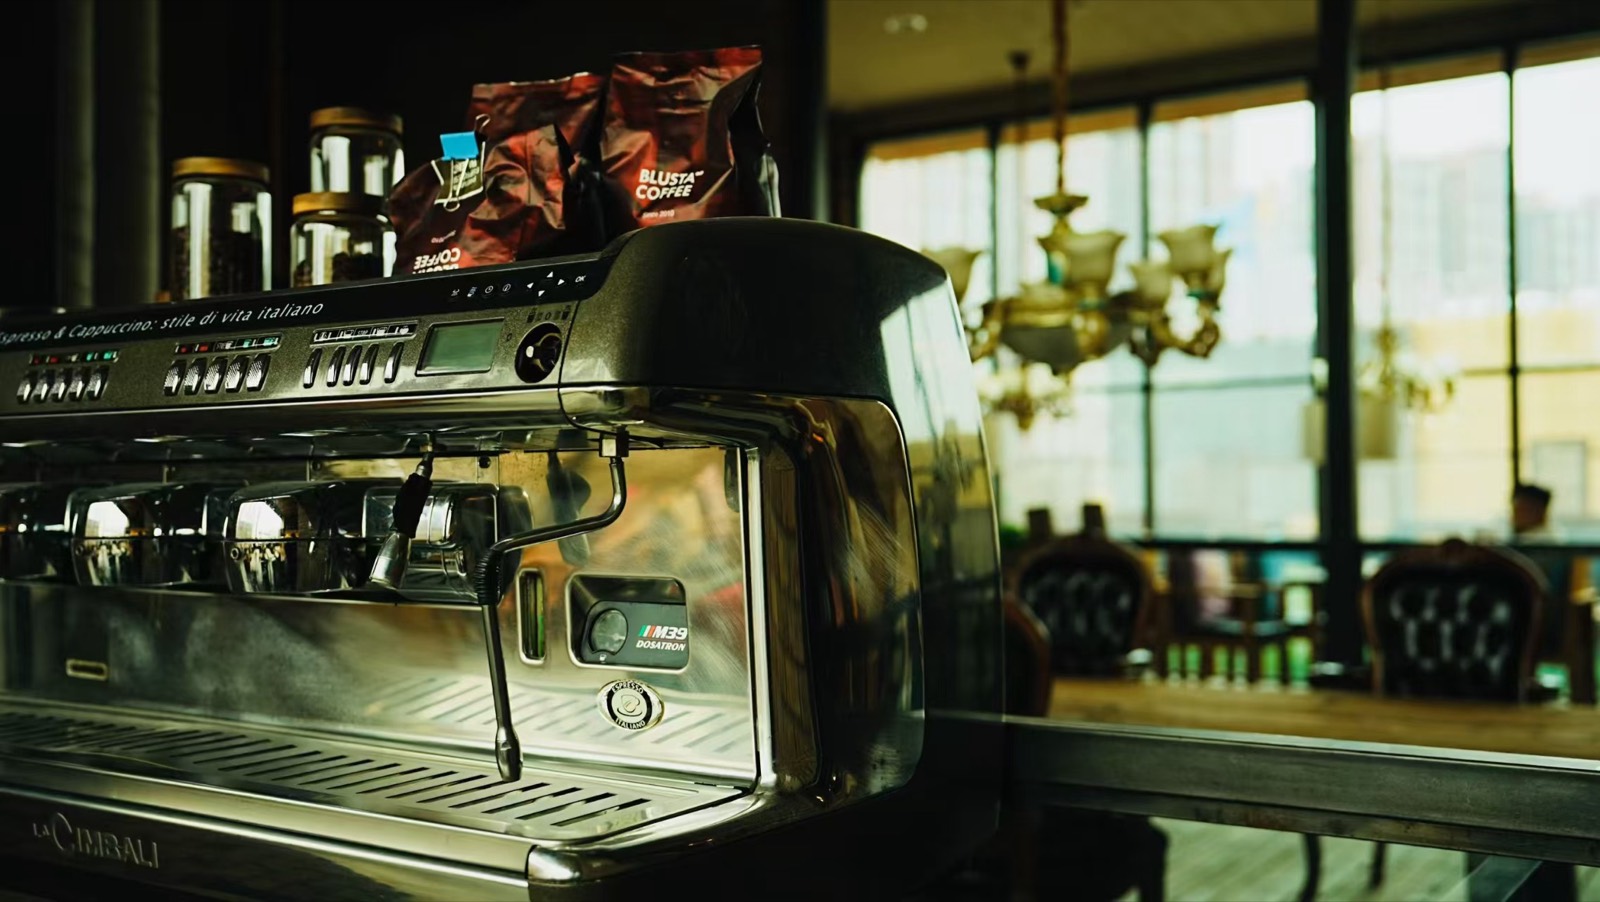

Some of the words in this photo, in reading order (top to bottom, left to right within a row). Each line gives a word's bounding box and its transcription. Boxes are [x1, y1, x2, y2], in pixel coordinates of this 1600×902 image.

[639, 168, 695, 186] BLUSTA
[635, 184, 693, 201] COFFEE
[413, 247, 461, 270] COFFEE
[54, 325, 67, 339] &
[69, 319, 158, 338] Cappuccino:
[160, 313, 196, 329] stile
[200, 310, 219, 325] di
[222, 309, 253, 323] vita
[257, 303, 324, 320] italiano
[636, 640, 686, 651] DOSATRON
[611, 680, 644, 694] ESPRESSO
[615, 717, 646, 730] ITALIANO
[52, 812, 159, 869] CIMBALI
